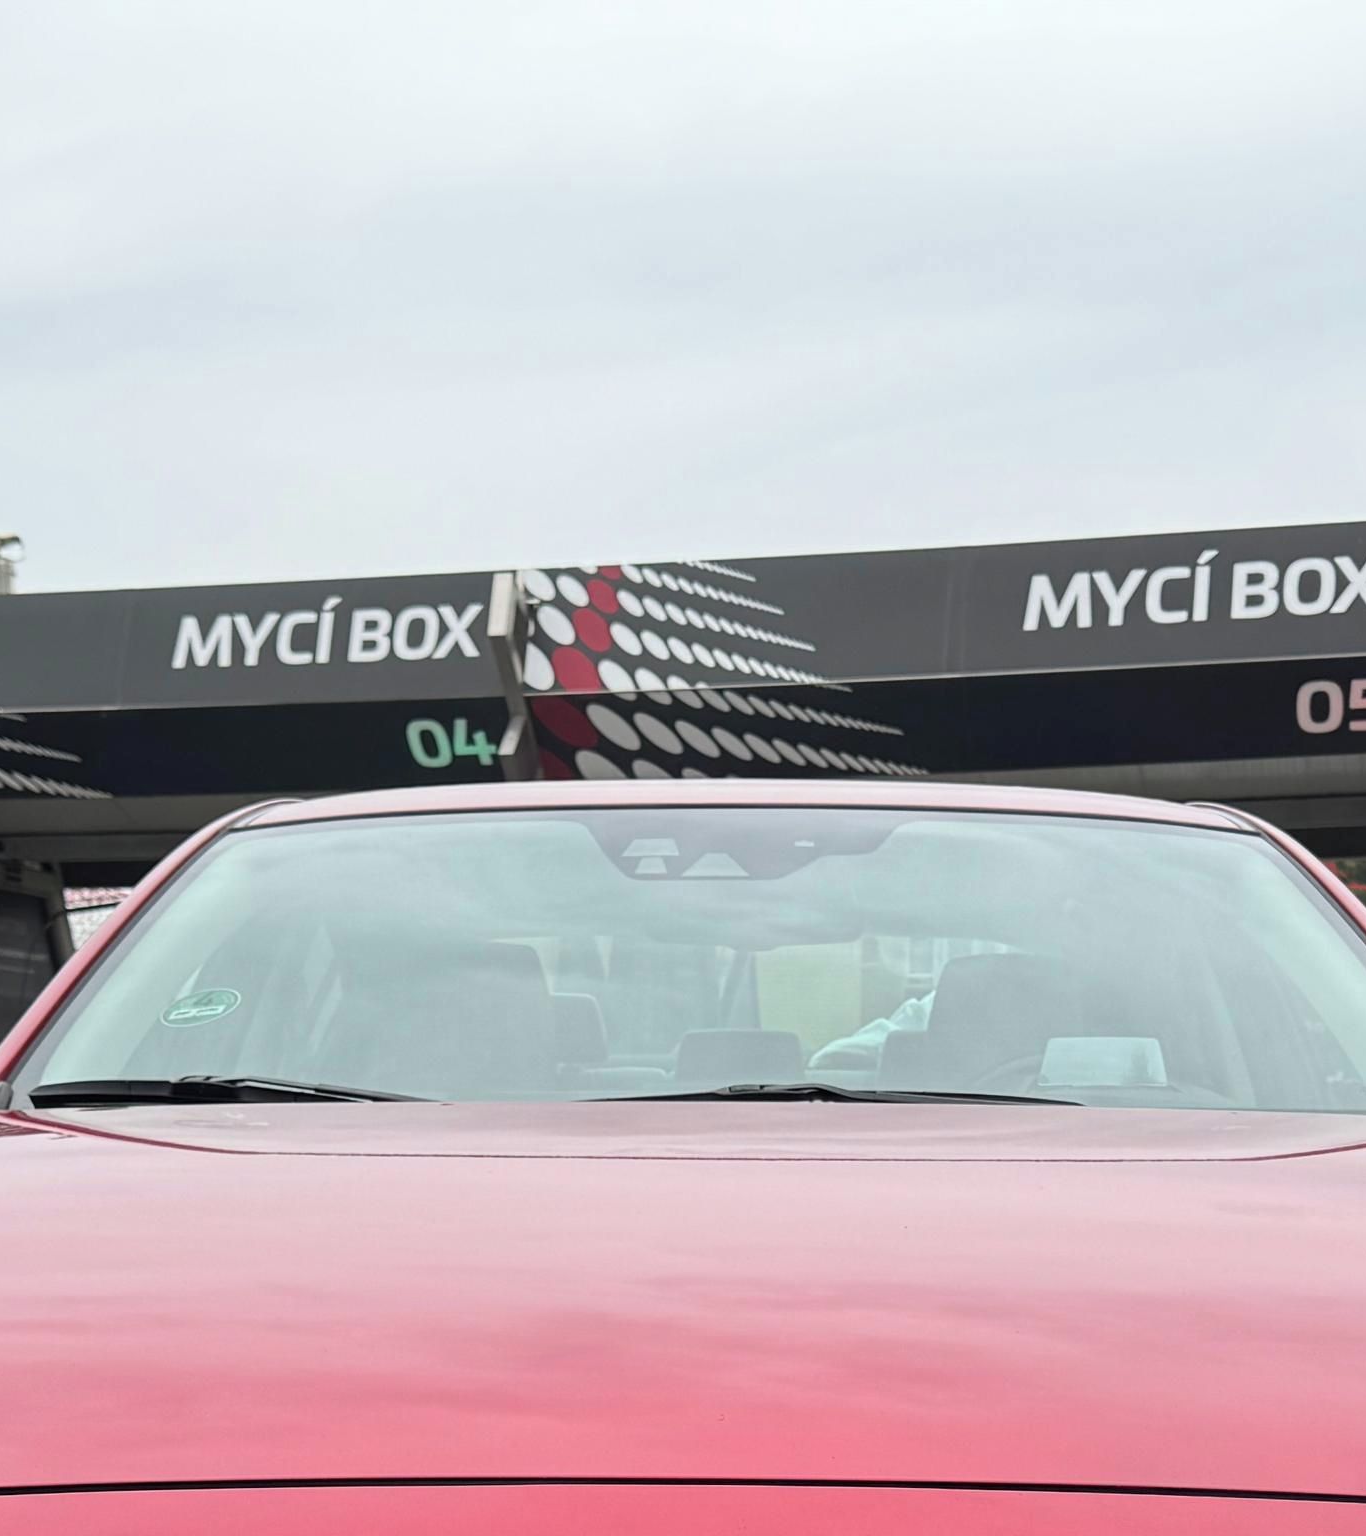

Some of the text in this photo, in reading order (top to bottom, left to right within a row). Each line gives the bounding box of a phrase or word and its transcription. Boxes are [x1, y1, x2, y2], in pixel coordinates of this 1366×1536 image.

[1023, 550, 1219, 631] MYCÍ
[171, 596, 483, 669] MYCÍ BOX
[406, 718, 497, 768] 04
